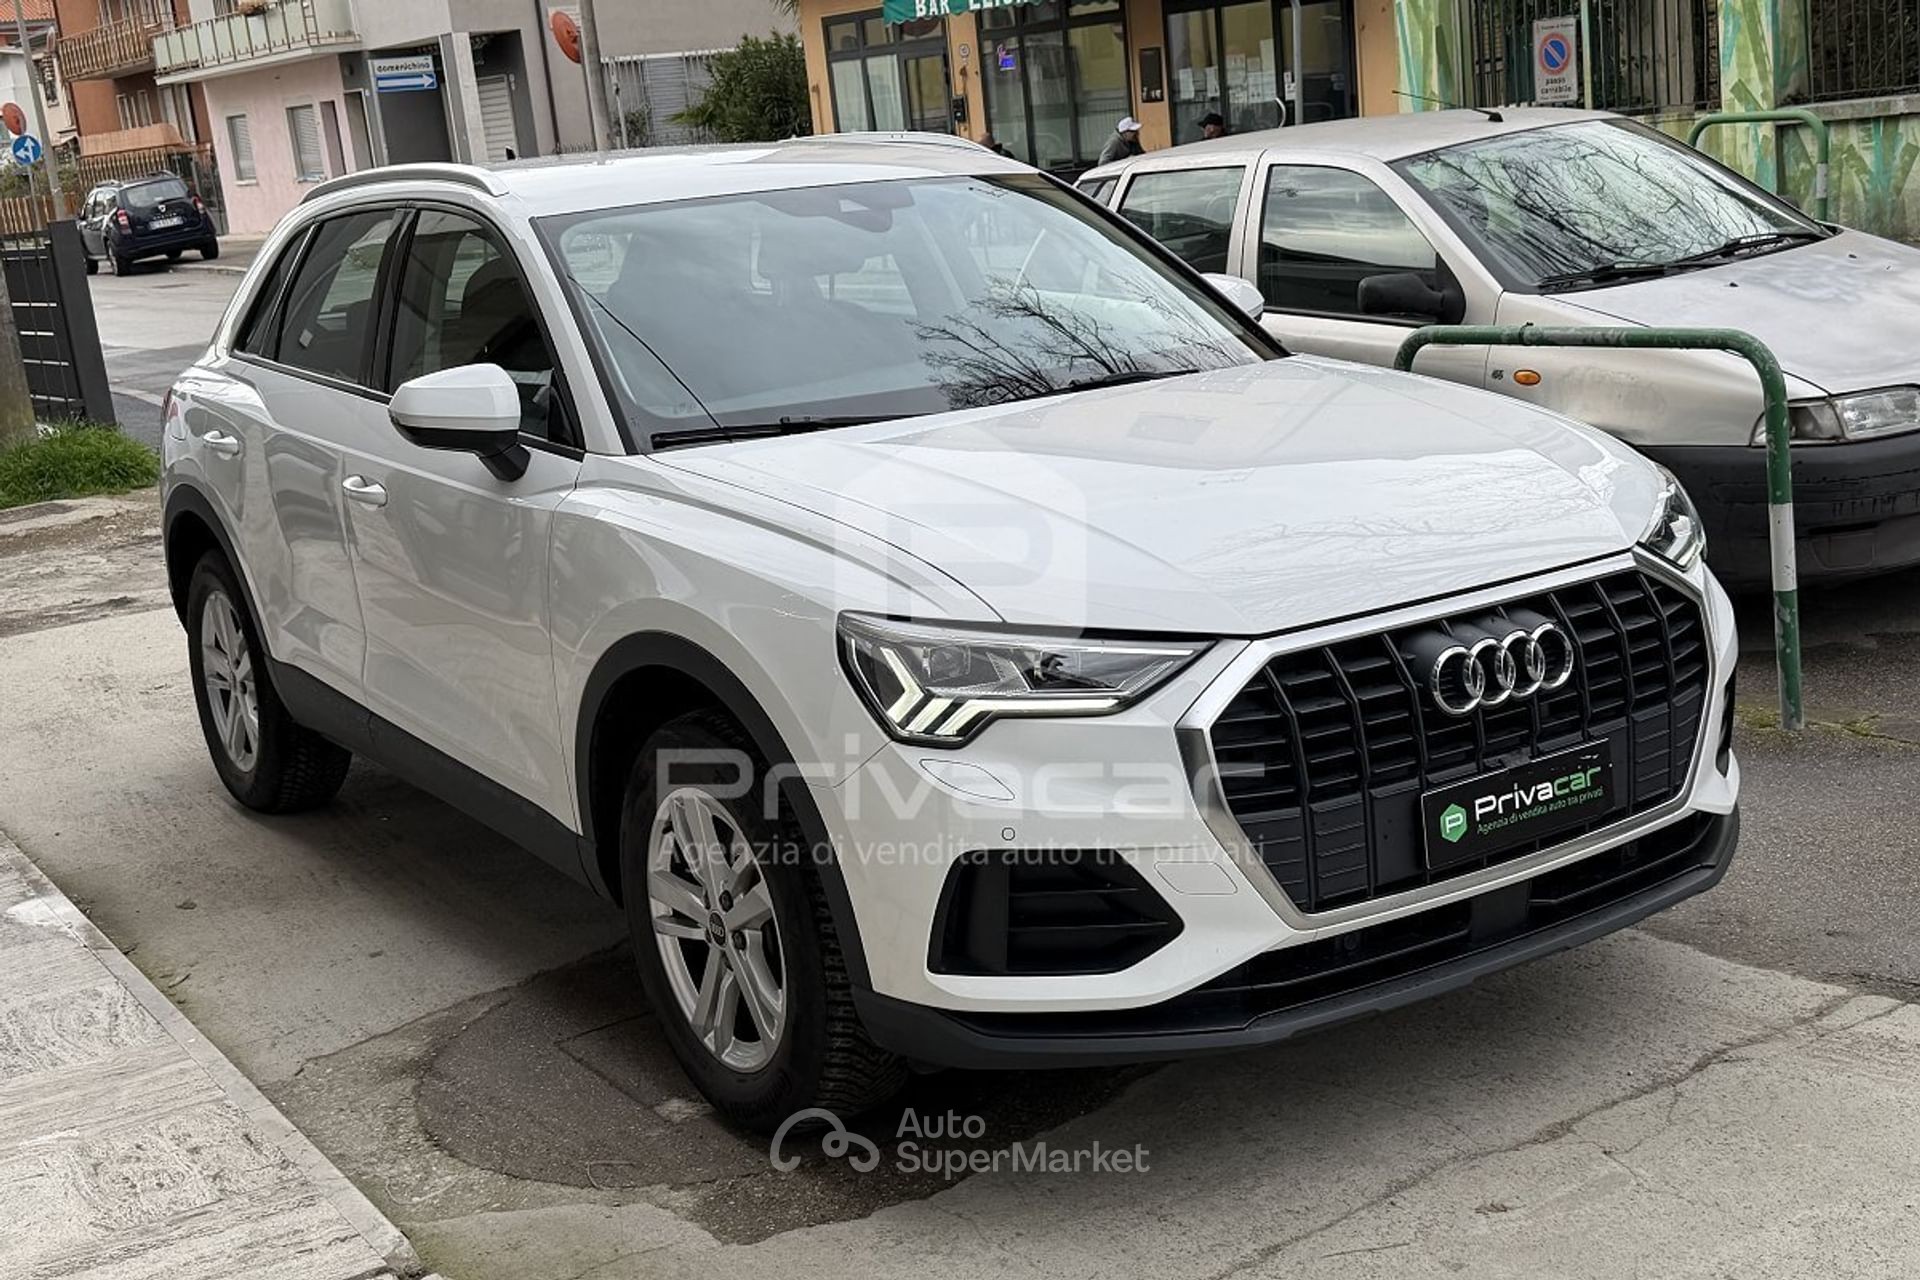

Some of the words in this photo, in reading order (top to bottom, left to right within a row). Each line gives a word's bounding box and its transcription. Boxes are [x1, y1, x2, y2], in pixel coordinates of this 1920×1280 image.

[916, 0, 950, 17] BAR
[1475, 766, 1601, 821] Privacar
[1477, 815, 1509, 836] Agenzia
[1509, 812, 1518, 824] di
[1519, 803, 1548, 820] vendita
[1549, 800, 1567, 812] auto
[1567, 796, 1579, 806] tra
[1579, 786, 1604, 805] privati
[1445, 812, 1464, 833] P
